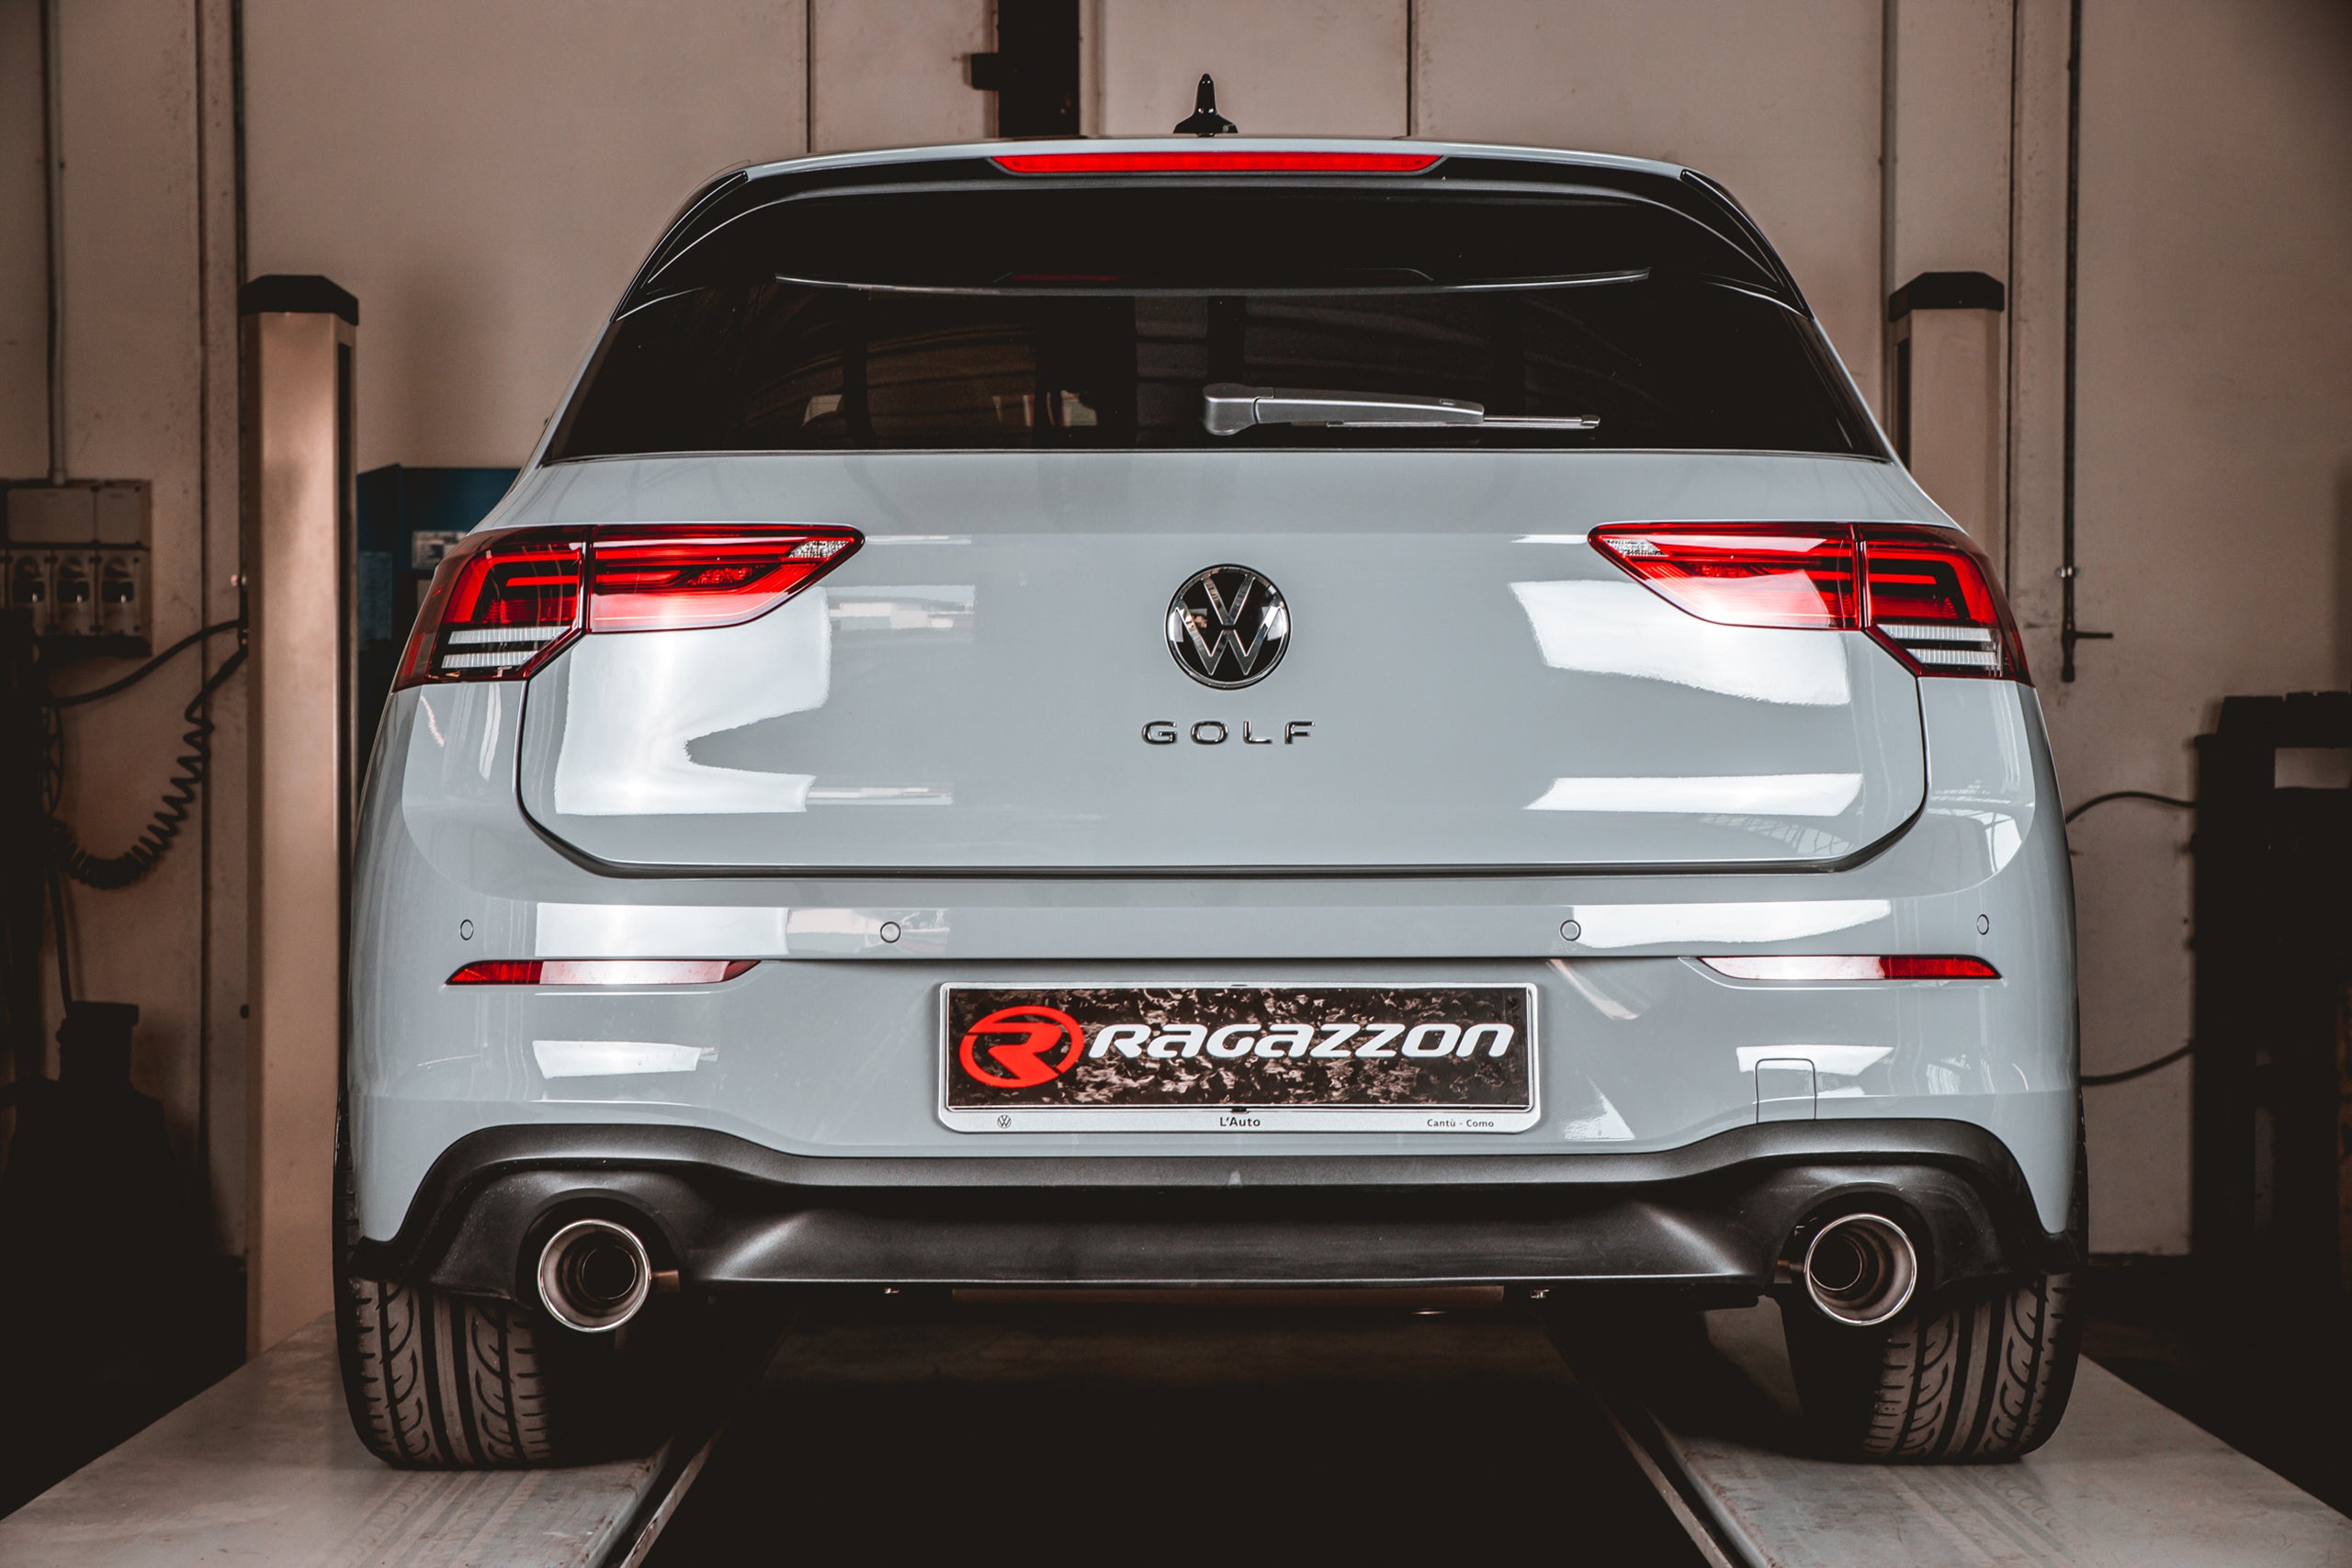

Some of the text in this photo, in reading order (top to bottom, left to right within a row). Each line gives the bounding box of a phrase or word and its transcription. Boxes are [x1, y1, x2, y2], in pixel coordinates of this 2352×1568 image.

[1142, 720, 1316, 745] GOLF
[1219, 1116, 1261, 1127] L'Auto
[1427, 1118, 1456, 1127] Cantù
[1466, 1119, 1494, 1127] Como
